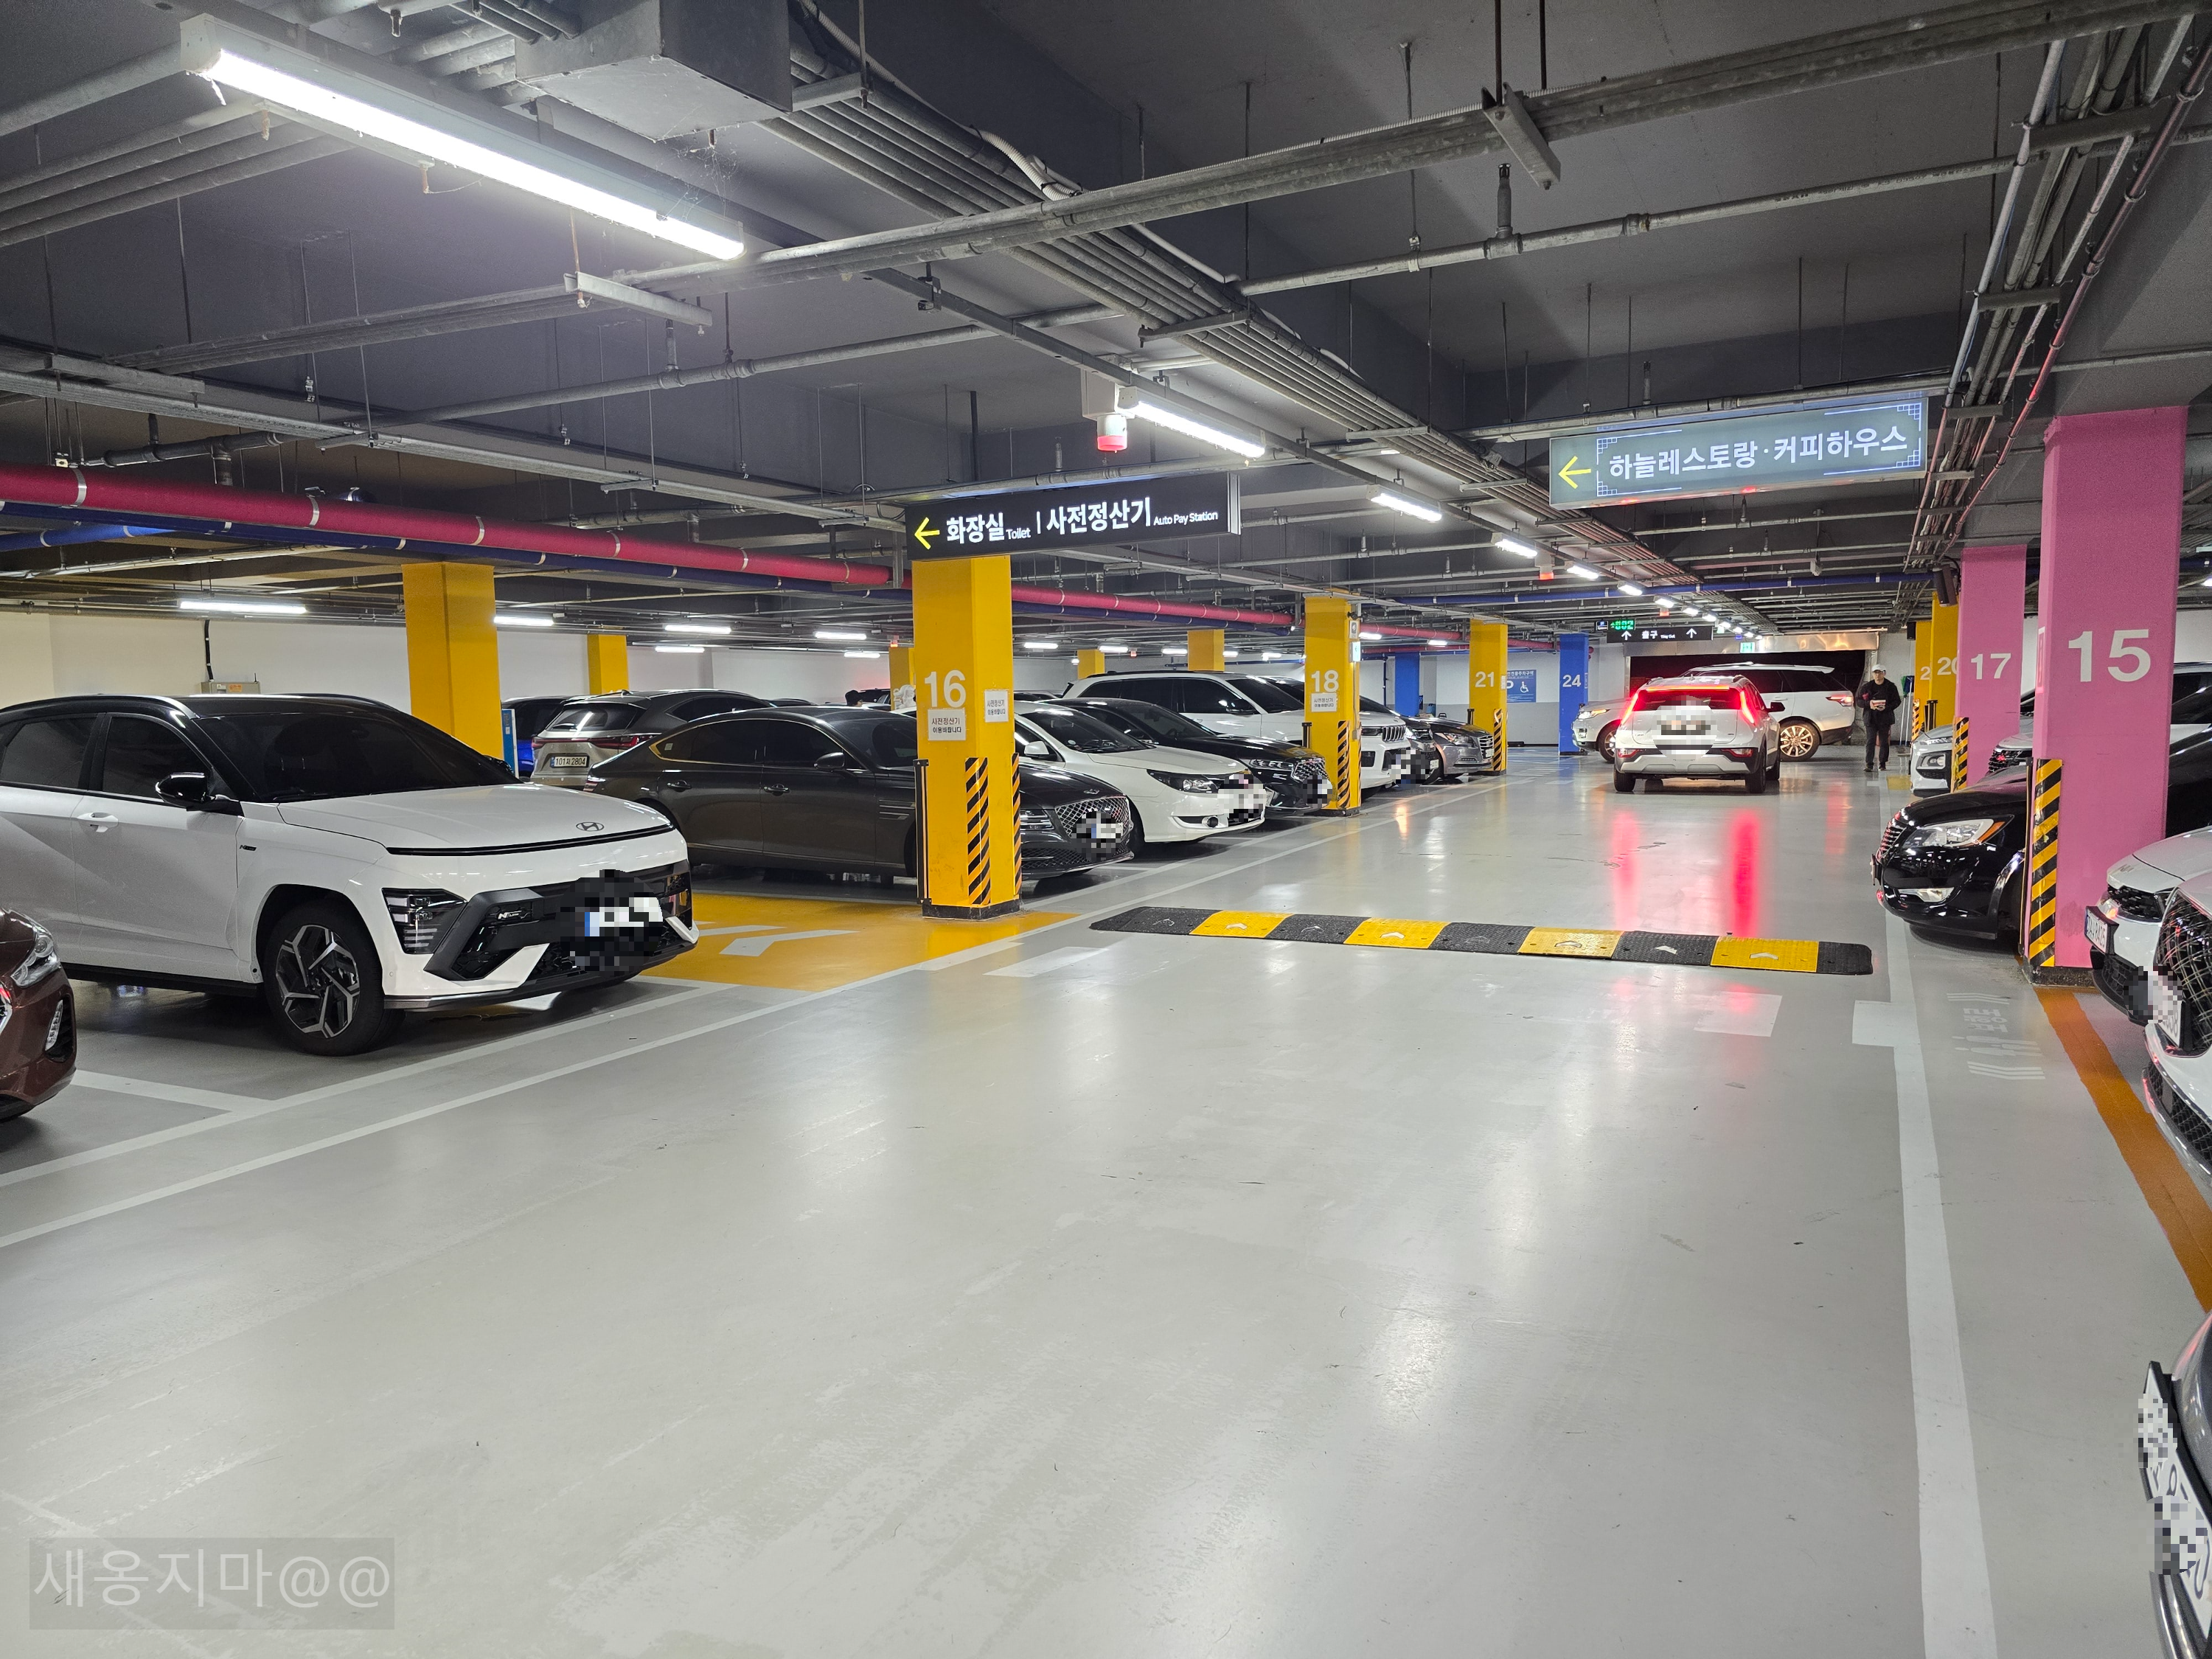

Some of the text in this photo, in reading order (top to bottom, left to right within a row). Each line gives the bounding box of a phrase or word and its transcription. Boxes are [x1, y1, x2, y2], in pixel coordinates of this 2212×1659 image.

[946, 496, 1219, 545] 화장실 Toilet 사전정산기 Auto Pay Station
[1970, 653, 2011, 680] 17
[2067, 629, 2152, 682] 15
[925, 669, 966, 708] 16
[1311, 669, 1339, 692] 18
[1475, 671, 1495, 687] 21
[1562, 674, 1582, 687] 24
[931, 717, 960, 726] 사전정산기
[571, 757, 586, 765] 2804
